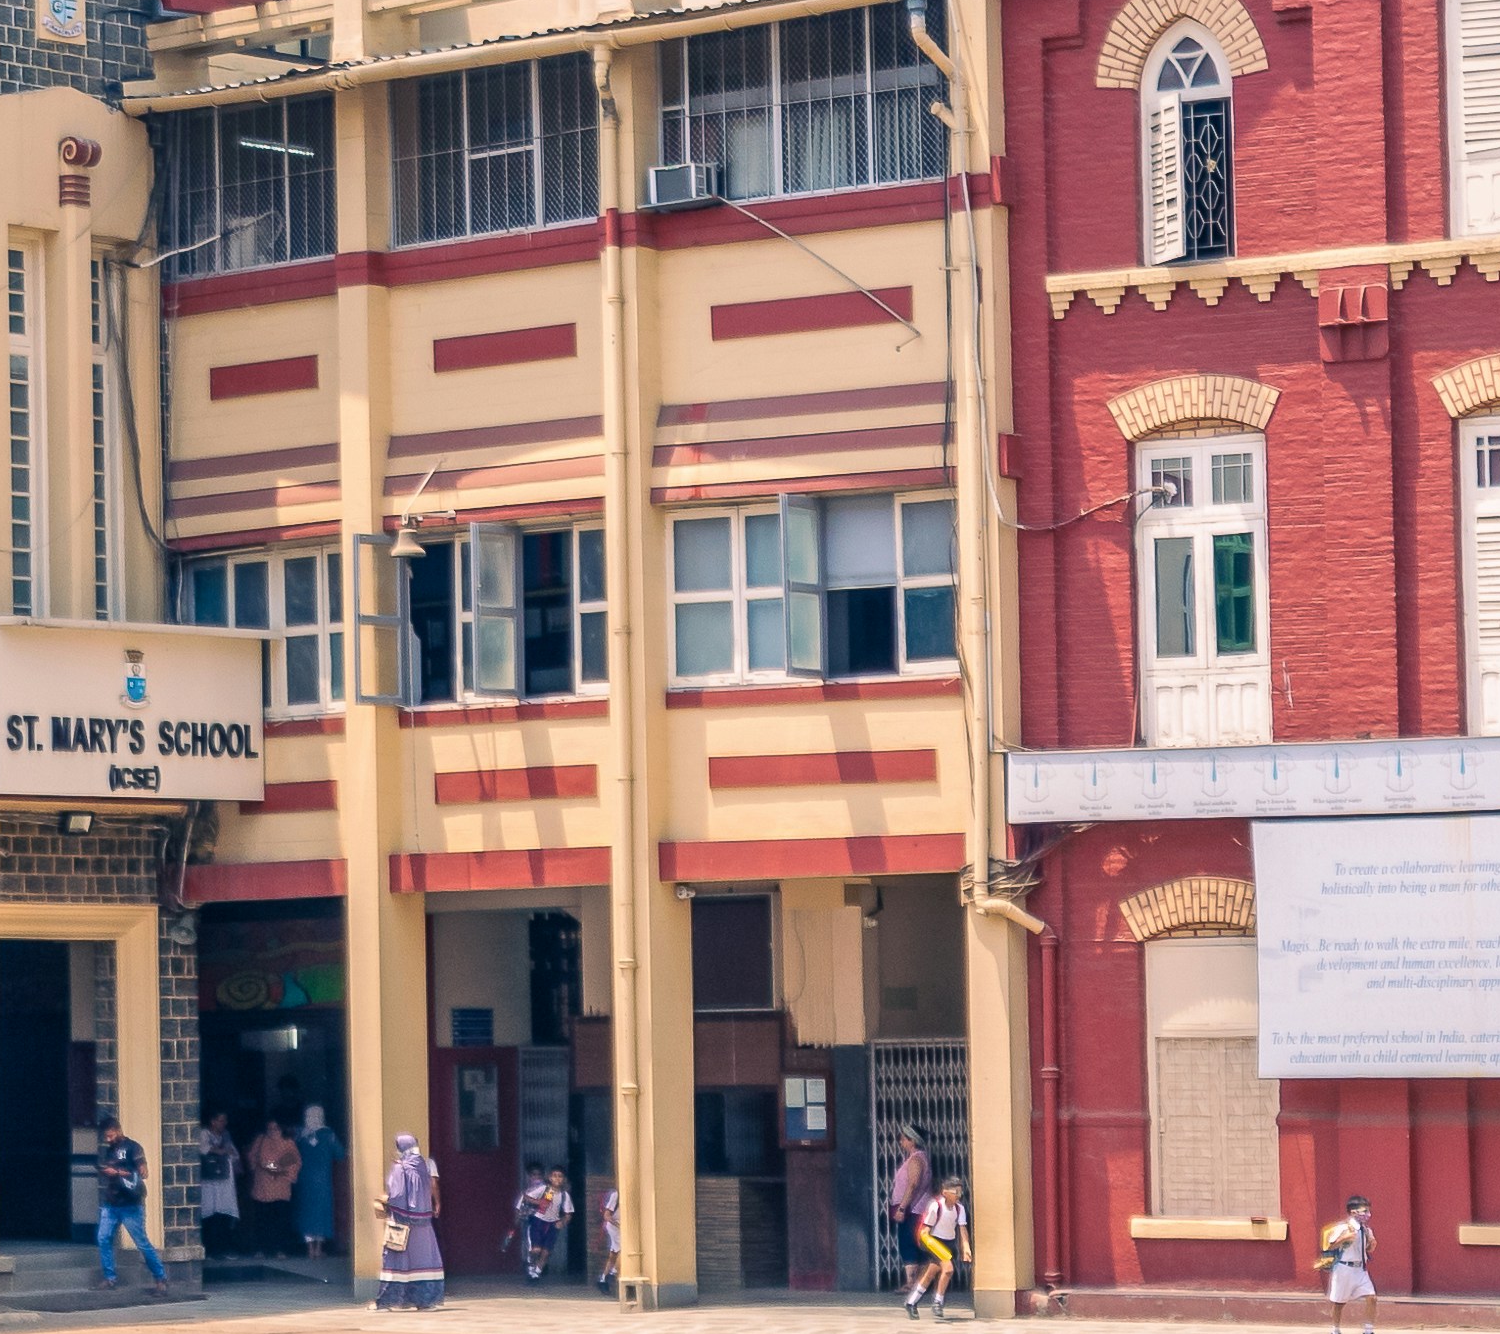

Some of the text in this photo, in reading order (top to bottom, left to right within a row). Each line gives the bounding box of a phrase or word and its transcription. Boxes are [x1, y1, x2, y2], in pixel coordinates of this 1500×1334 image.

[6, 714, 259, 759] ST. MARY'S SCHOOL
[108, 764, 161, 793] (ICSE)
